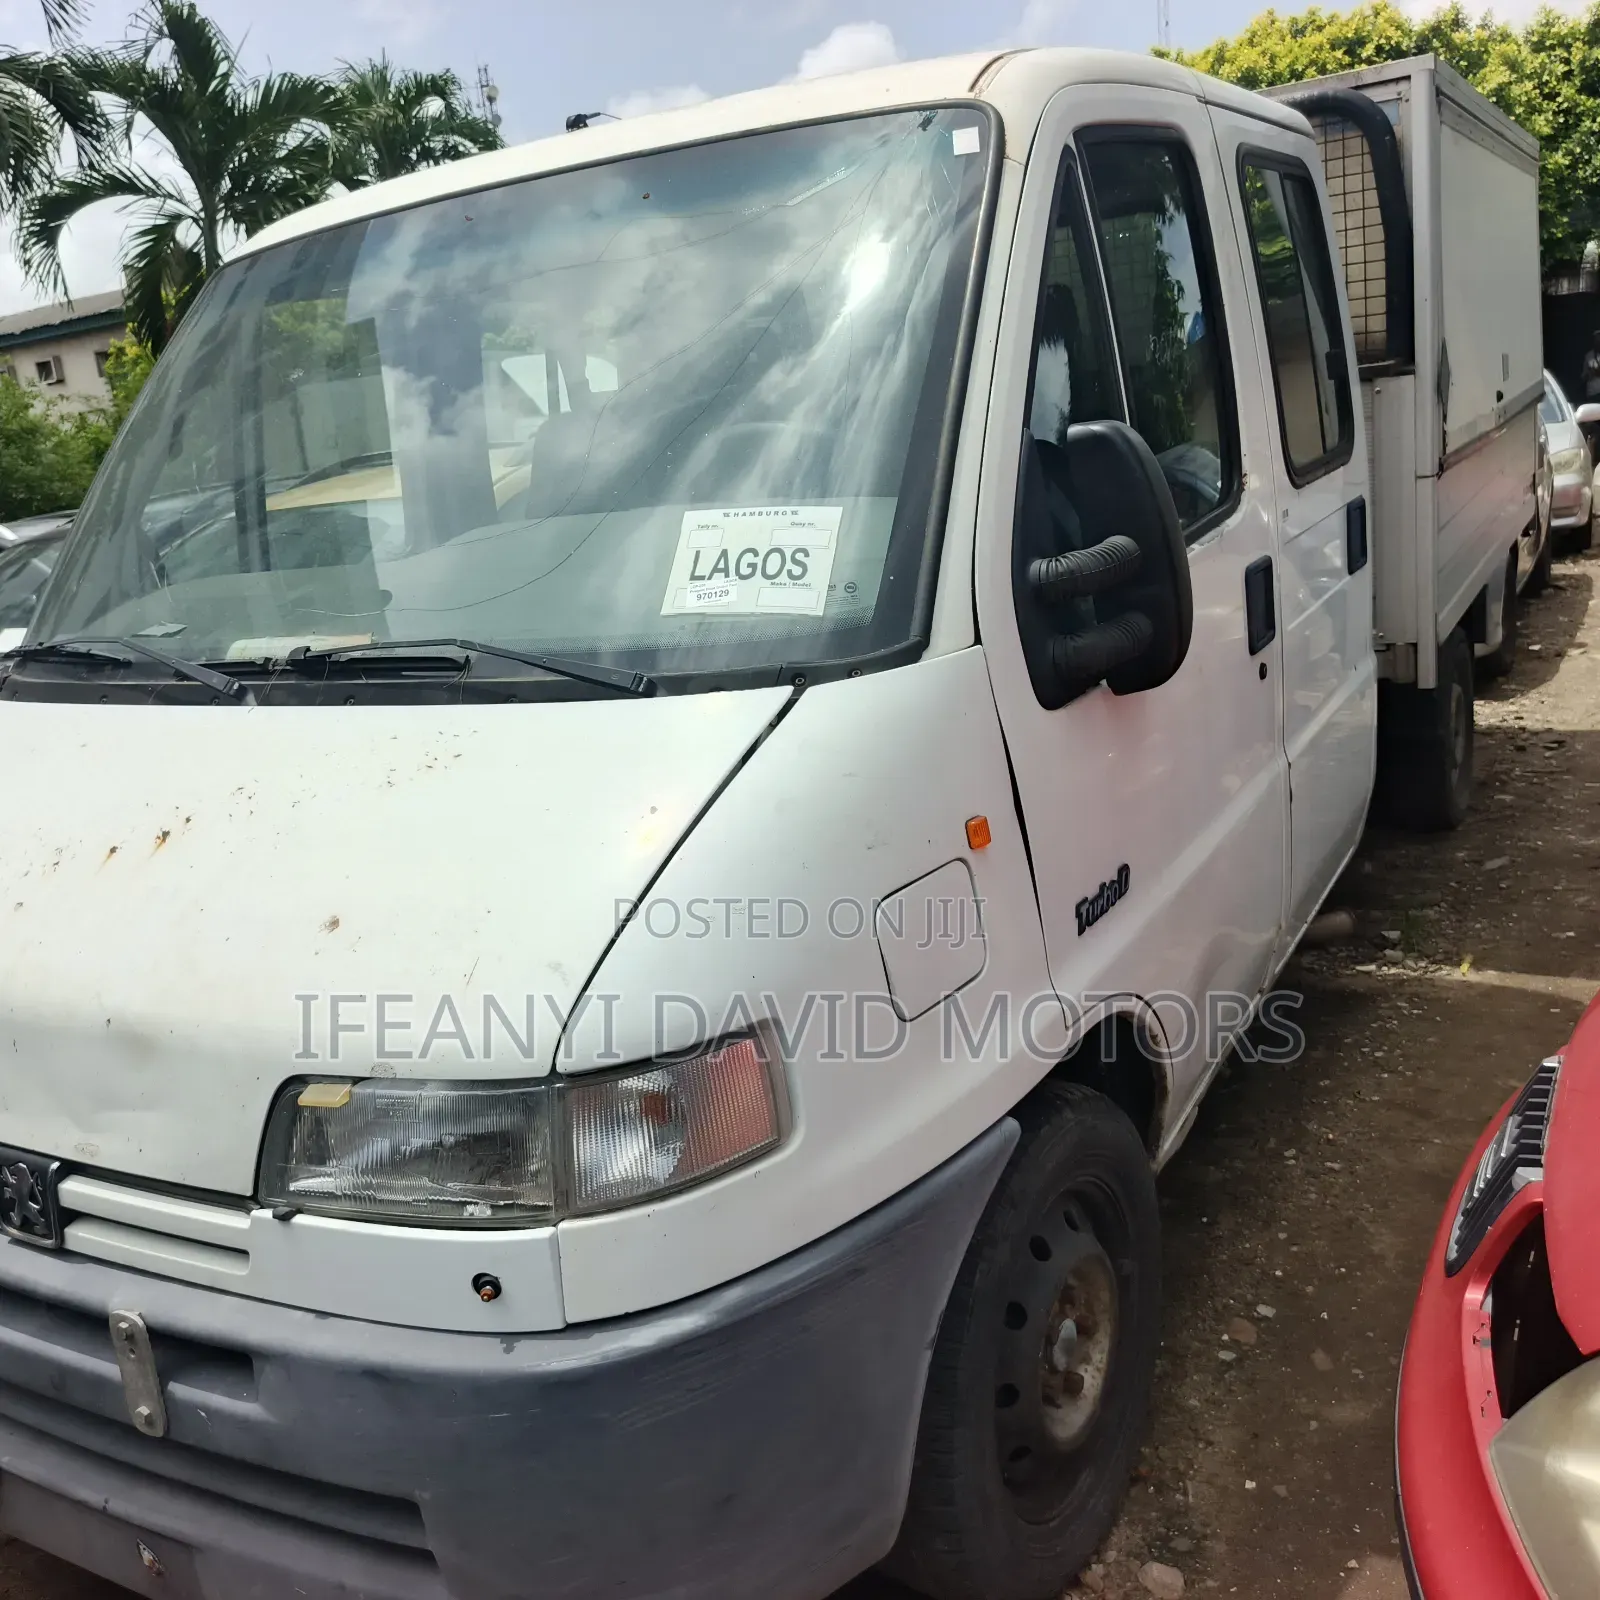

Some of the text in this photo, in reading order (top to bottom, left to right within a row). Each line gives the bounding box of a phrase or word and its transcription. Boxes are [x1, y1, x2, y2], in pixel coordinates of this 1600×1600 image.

[733, 510, 788, 518] HAMBURG
[689, 547, 810, 581] LAGOS
[696, 589, 730, 601] 970129
